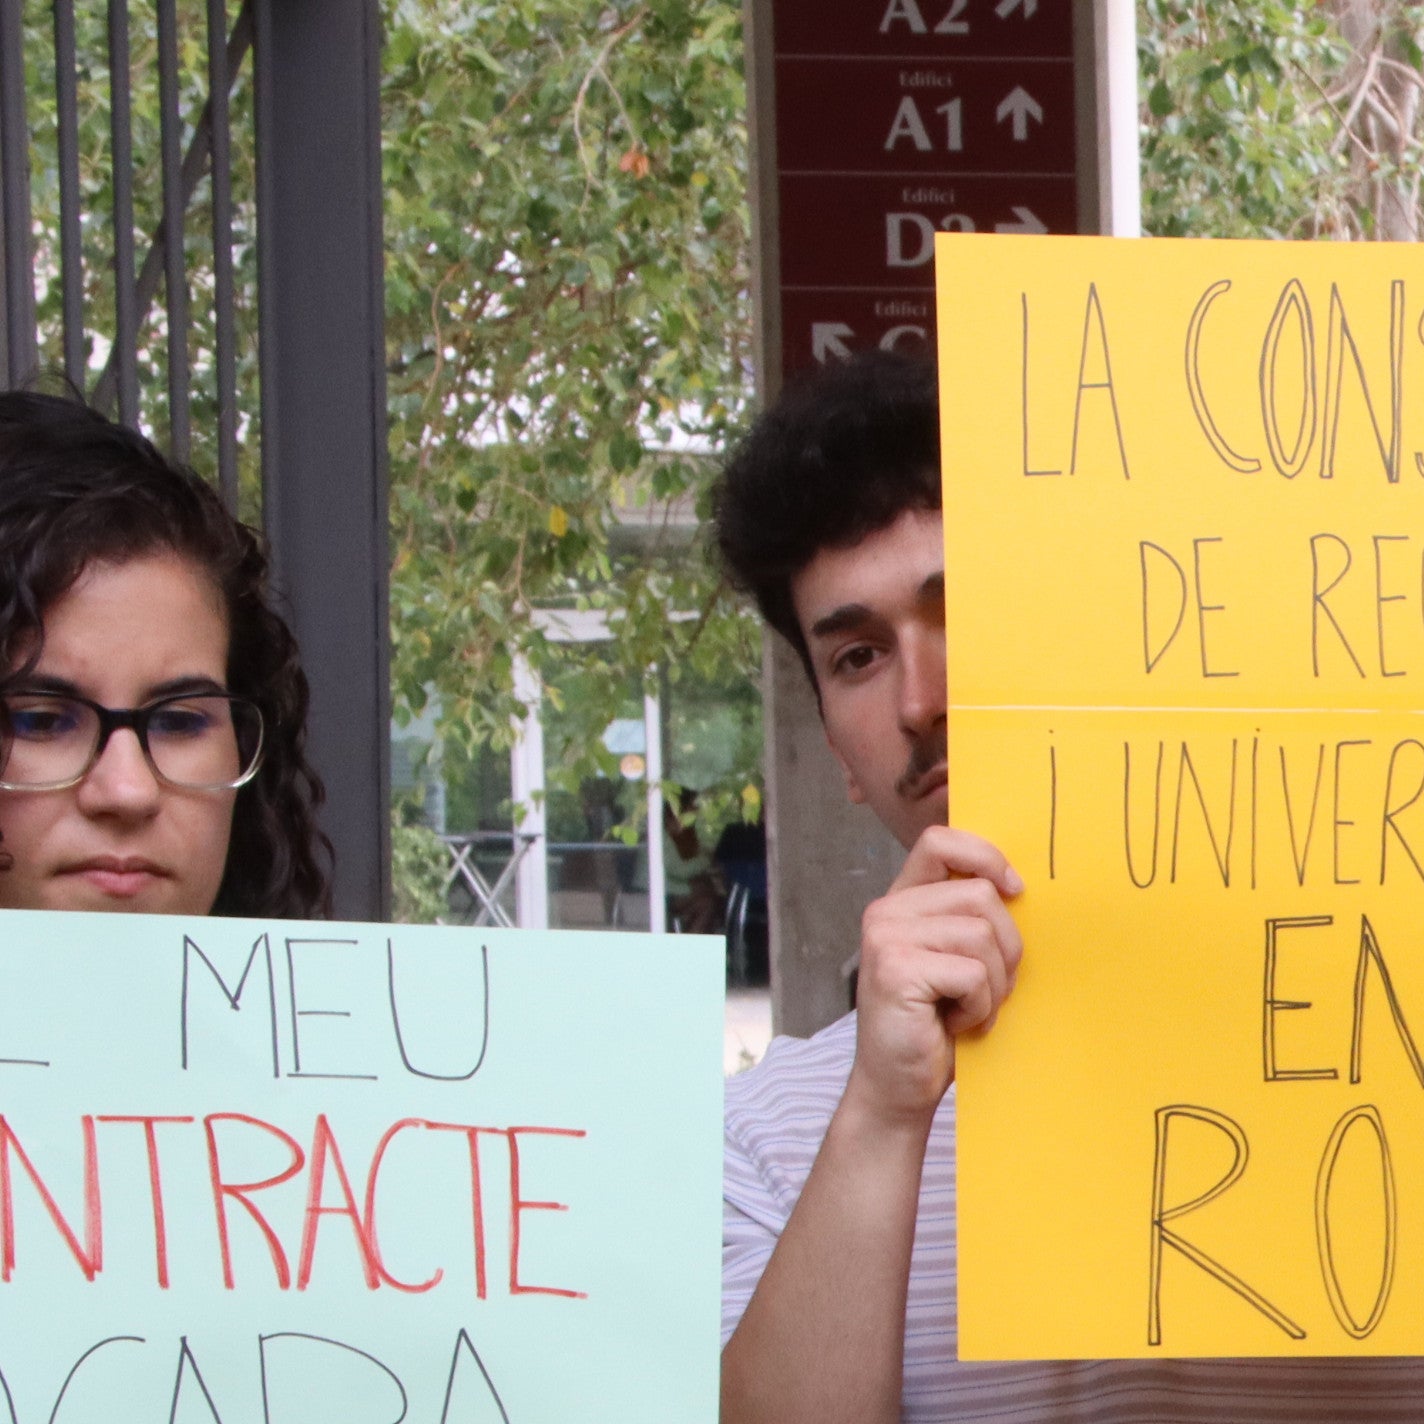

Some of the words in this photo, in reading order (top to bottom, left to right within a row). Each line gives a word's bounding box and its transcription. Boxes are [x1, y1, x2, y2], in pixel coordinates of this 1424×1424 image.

[879, 0, 970, 34] A2
[884, 95, 963, 151] A1
[1022, 281, 1130, 479] LA
[1139, 537, 1241, 677] DE
[181, 933, 488, 1081] MEU
